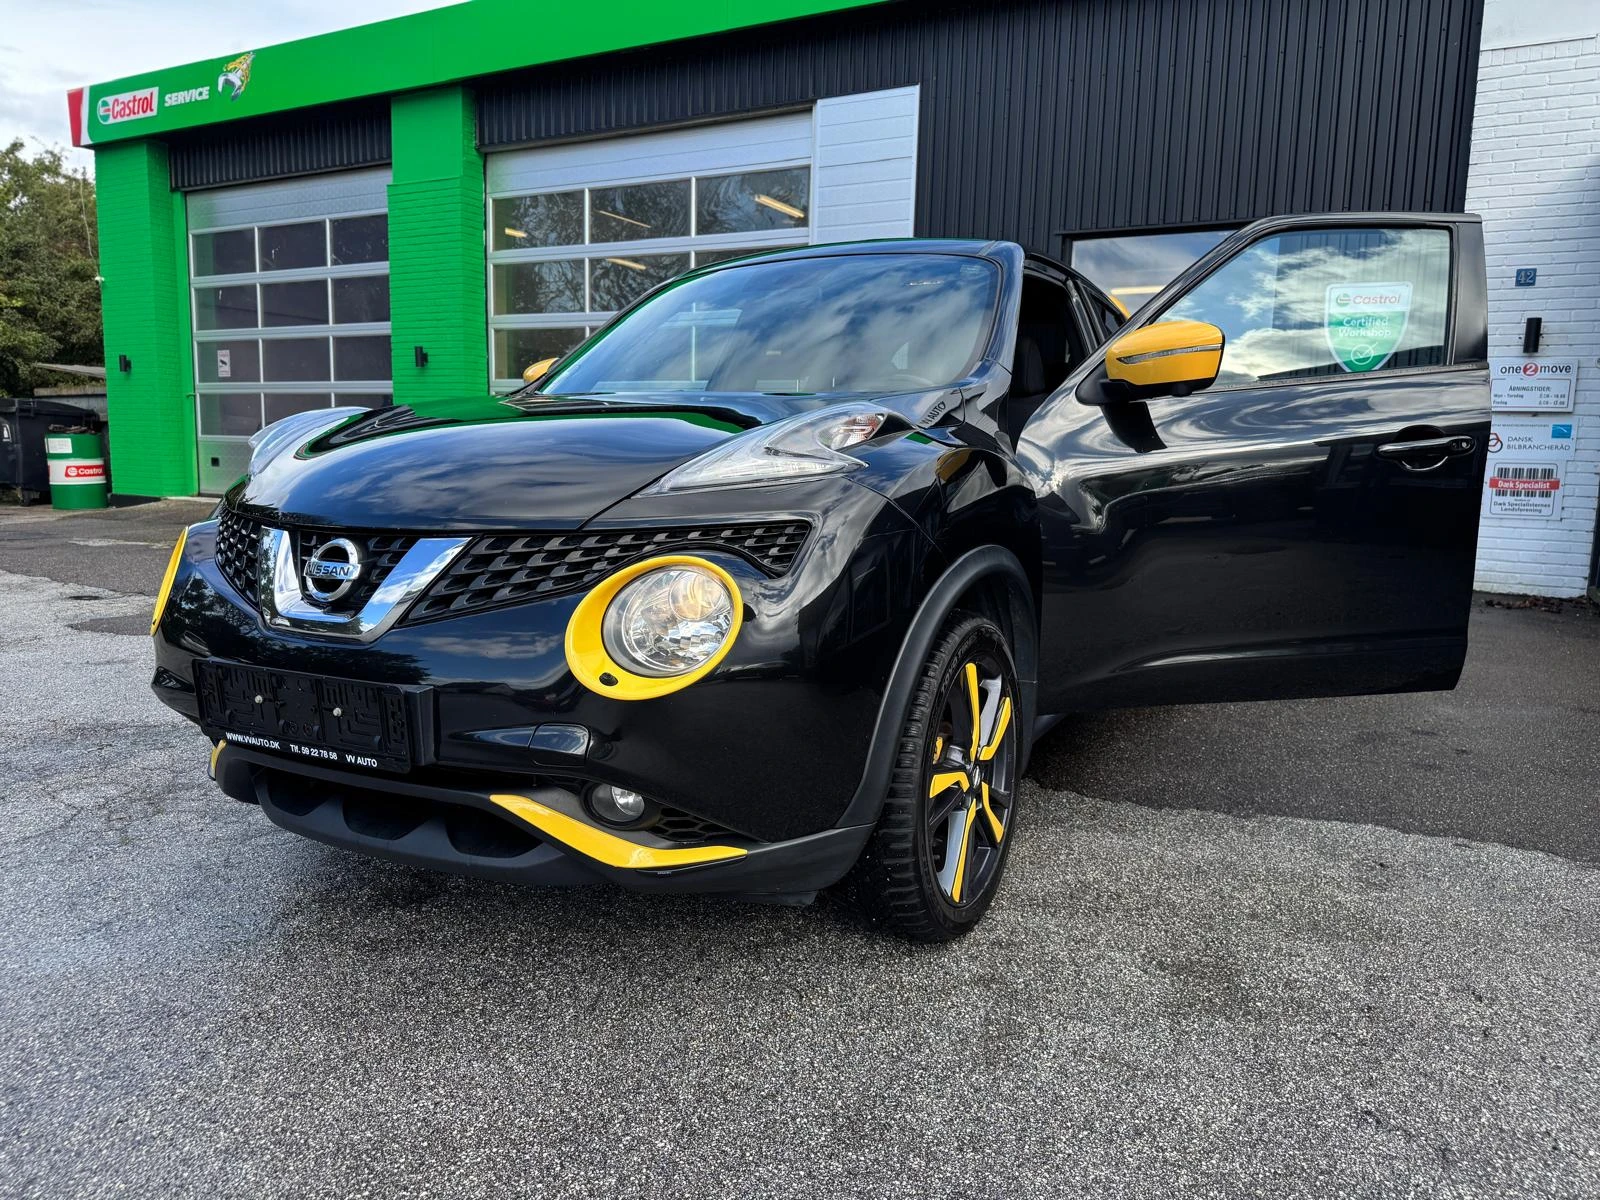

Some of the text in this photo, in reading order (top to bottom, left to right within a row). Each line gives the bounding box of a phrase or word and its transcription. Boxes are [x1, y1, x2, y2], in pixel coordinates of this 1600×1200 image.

[111, 86, 210, 119] Castrol SERVICE
[1519, 270, 1534, 284] 42
[1352, 293, 1402, 305] Castrol
[1343, 316, 1389, 328] Certified
[1338, 327, 1392, 338] Workshop
[927, 400, 946, 422] AUTO
[1515, 481, 1550, 490] Specialist
[307, 562, 350, 576] NISSAN
[225, 731, 280, 750] WWW.VVAUTO.DK
[310, 748, 319, 757] 22
[345, 754, 355, 763] VV
[356, 756, 378, 768] AUTO
